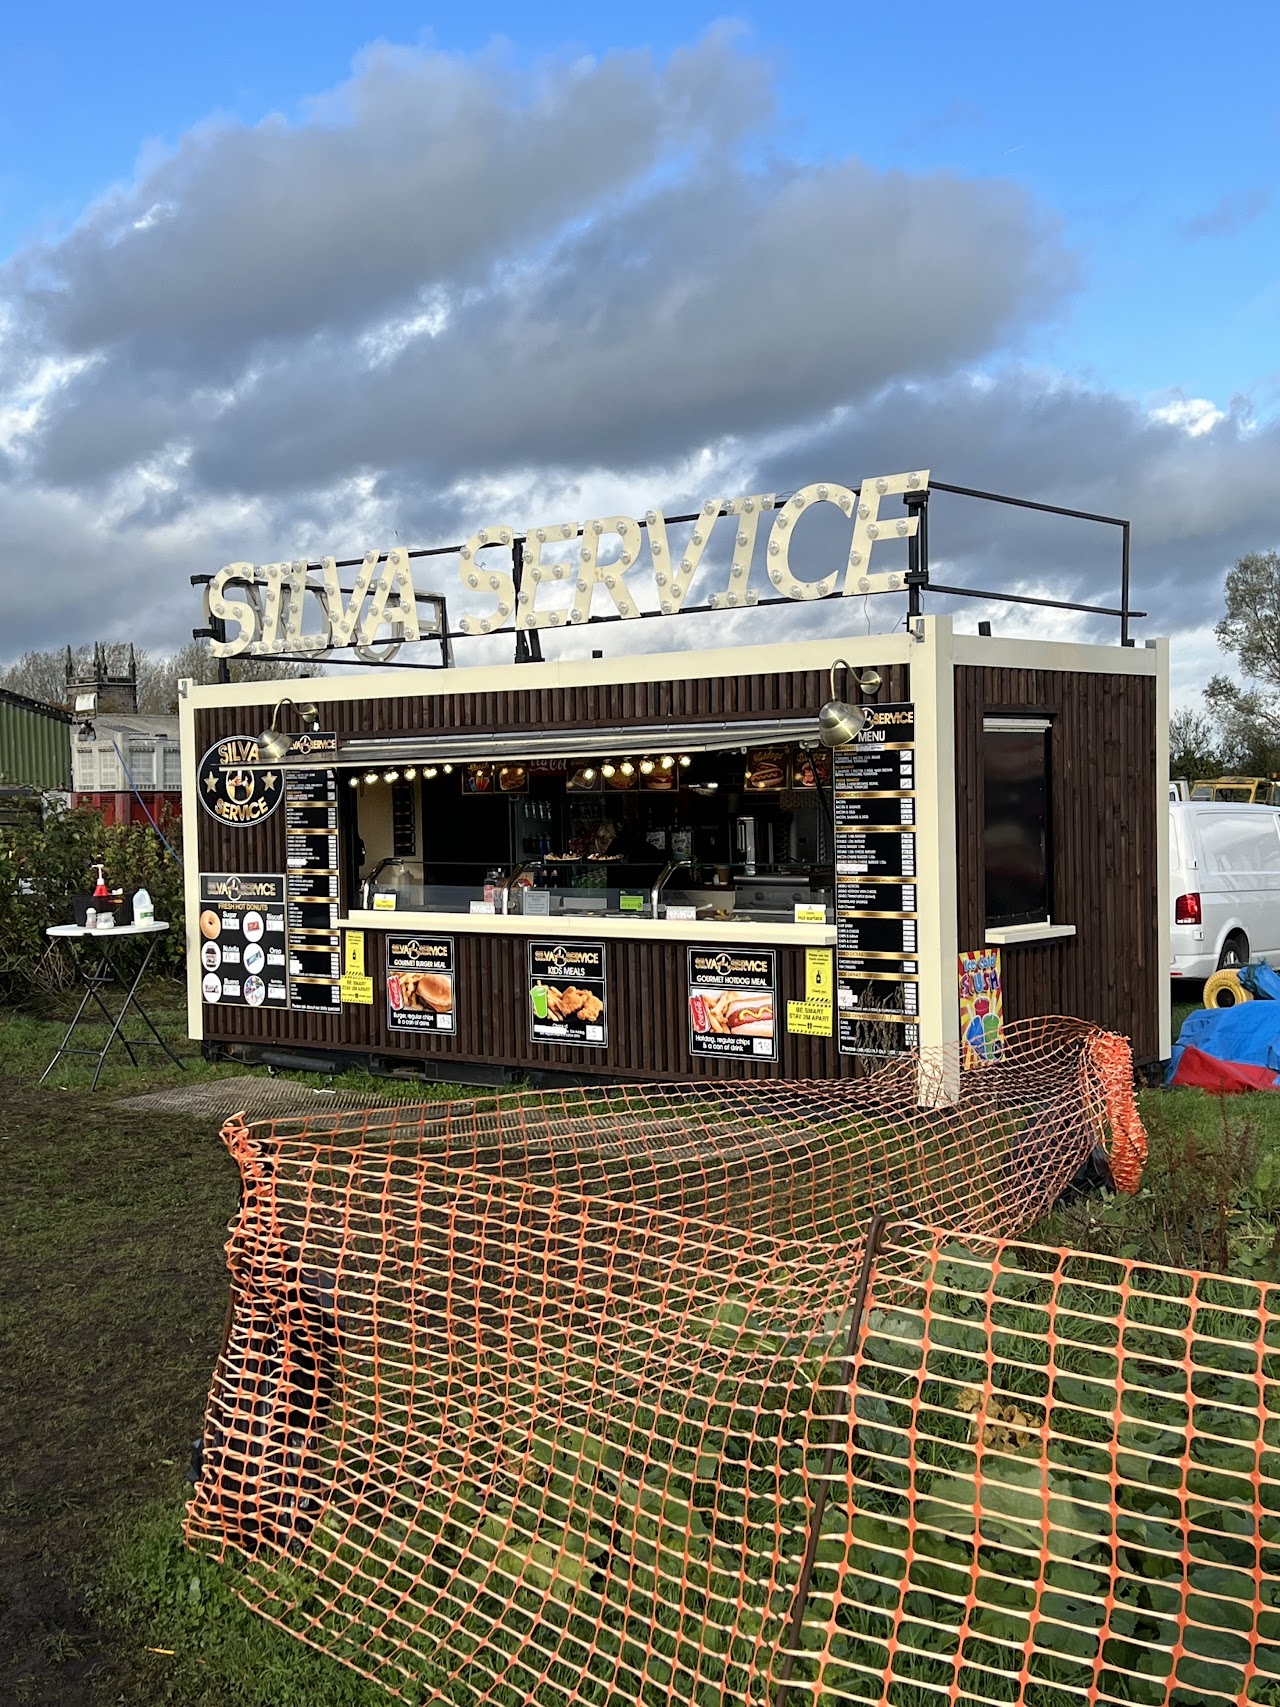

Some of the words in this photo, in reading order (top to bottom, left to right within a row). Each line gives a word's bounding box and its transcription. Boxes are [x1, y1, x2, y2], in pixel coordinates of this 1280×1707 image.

[209, 546, 420, 658] SILVA
[459, 469, 931, 635] SERVICE
[873, 711, 914, 725] SERVICE
[858, 730, 886, 742] MENU
[218, 740, 260, 764] SILVA
[214, 796, 268, 822] SERVICE
[207, 882, 228, 895] SILVA
[240, 882, 276, 896] SERVICE
[222, 911, 238, 919] Sugar
[392, 944, 409, 954] SILVA
[419, 945, 448, 957] SERVICE
[534, 950, 556, 961] SILVA
[566, 951, 599, 964] SERVICE
[394, 959, 415, 967] GOURMET
[695, 957, 718, 969] SILVA
[730, 959, 768, 972] SERVICE
[964, 959, 976, 972] Ice
[978, 952, 996, 972] Cold
[548, 966, 562, 975] KIDS
[563, 966, 585, 976] MEALS
[696, 974, 724, 983] GOURMET
[725, 976, 750, 985] HOTDOG
[751, 978, 767, 986] MEAL
[960, 968, 1000, 998] SLUSH
[695, 1035, 716, 1043] Hotdog,
[717, 1037, 735, 1045] regular
[736, 1038, 750, 1046] chips
